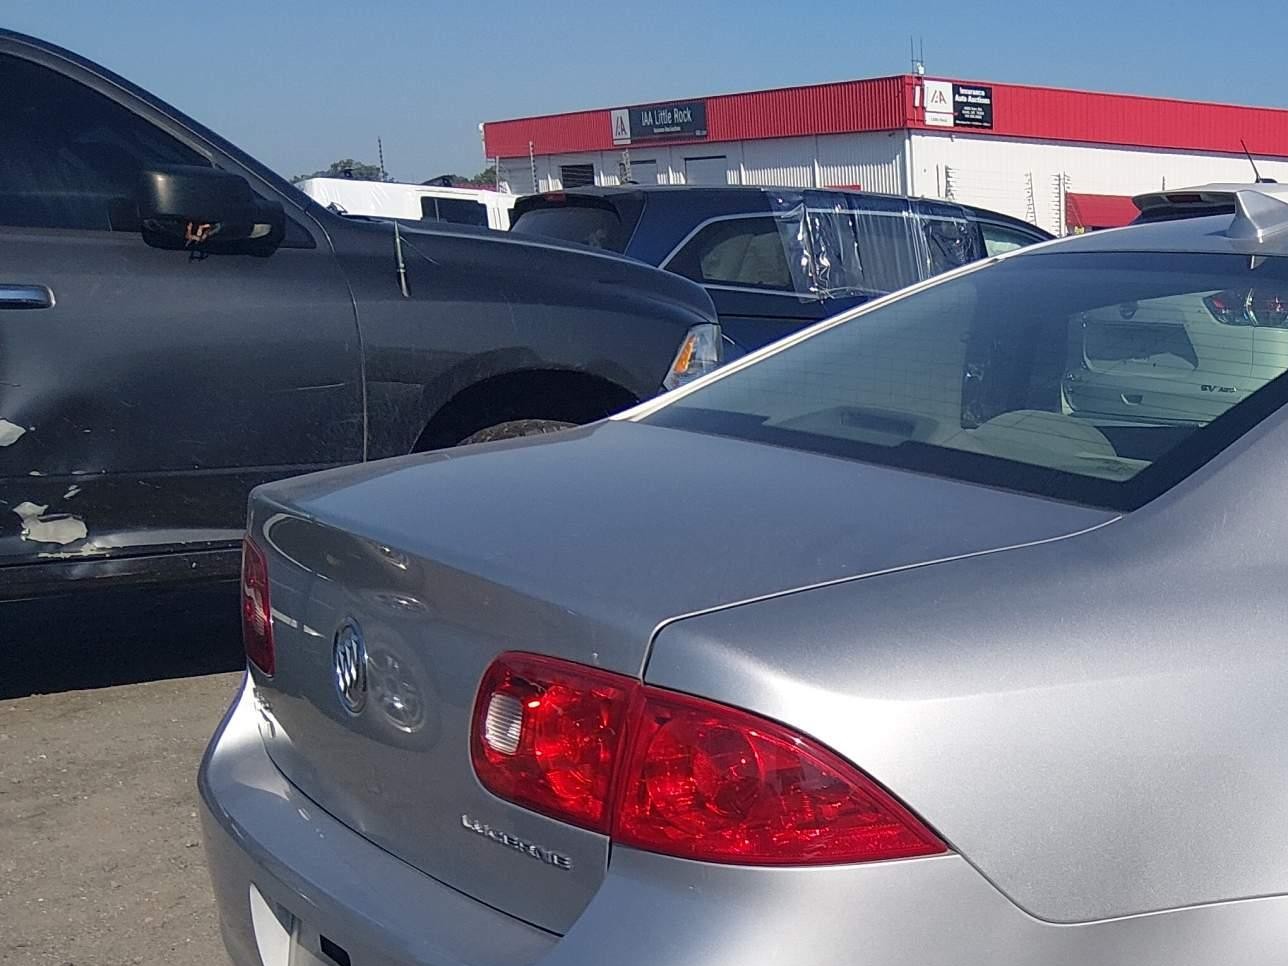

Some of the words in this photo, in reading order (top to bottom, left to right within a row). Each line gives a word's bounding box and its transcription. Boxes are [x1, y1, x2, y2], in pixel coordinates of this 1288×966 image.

[641, 111, 654, 126] IAA
[654, 109, 672, 124] Little
[674, 107, 692, 123] Rock
[462, 813, 573, 871] LUCERNE
